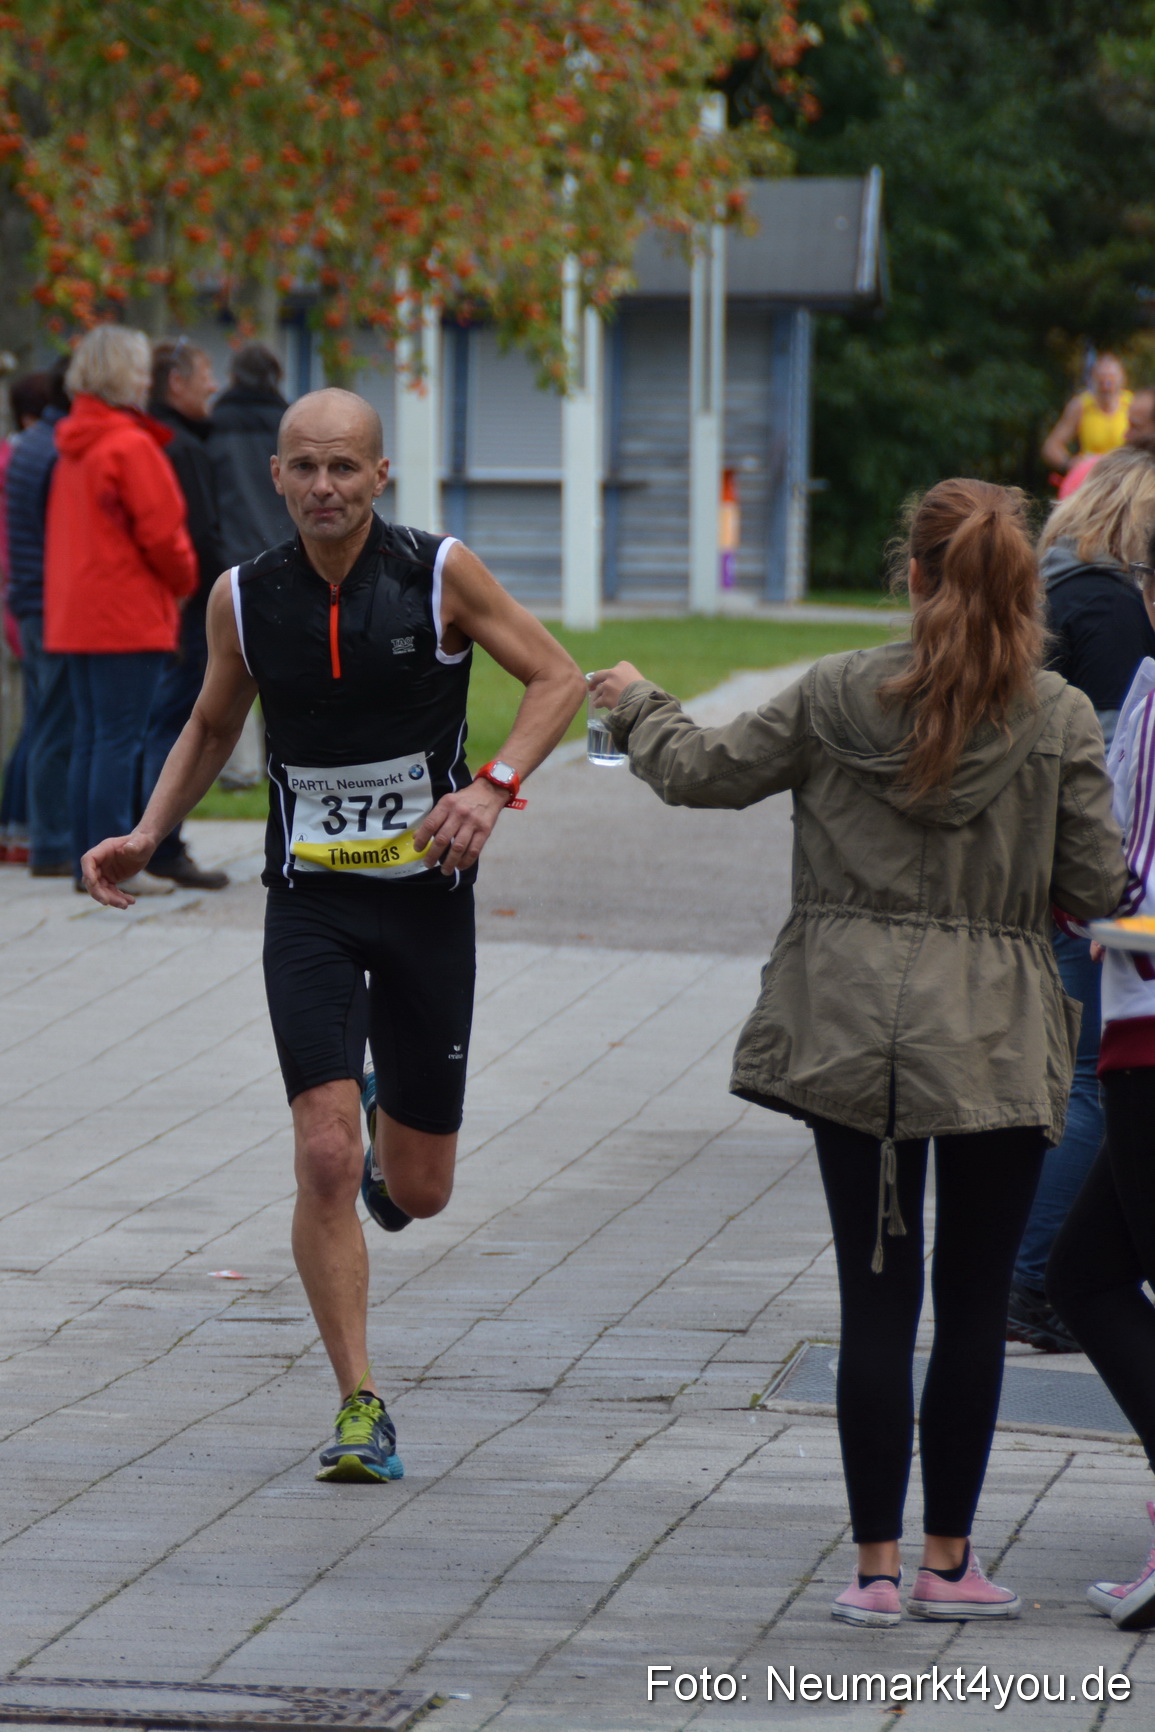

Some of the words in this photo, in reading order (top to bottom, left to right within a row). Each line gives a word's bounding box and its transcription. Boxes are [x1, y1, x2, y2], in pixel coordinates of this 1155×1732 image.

[291, 778, 334, 791] PARTL
[337, 773, 404, 790] Neumarkt
[321, 792, 408, 836] 372
[298, 834, 305, 842] A
[328, 846, 400, 866] Thomas
